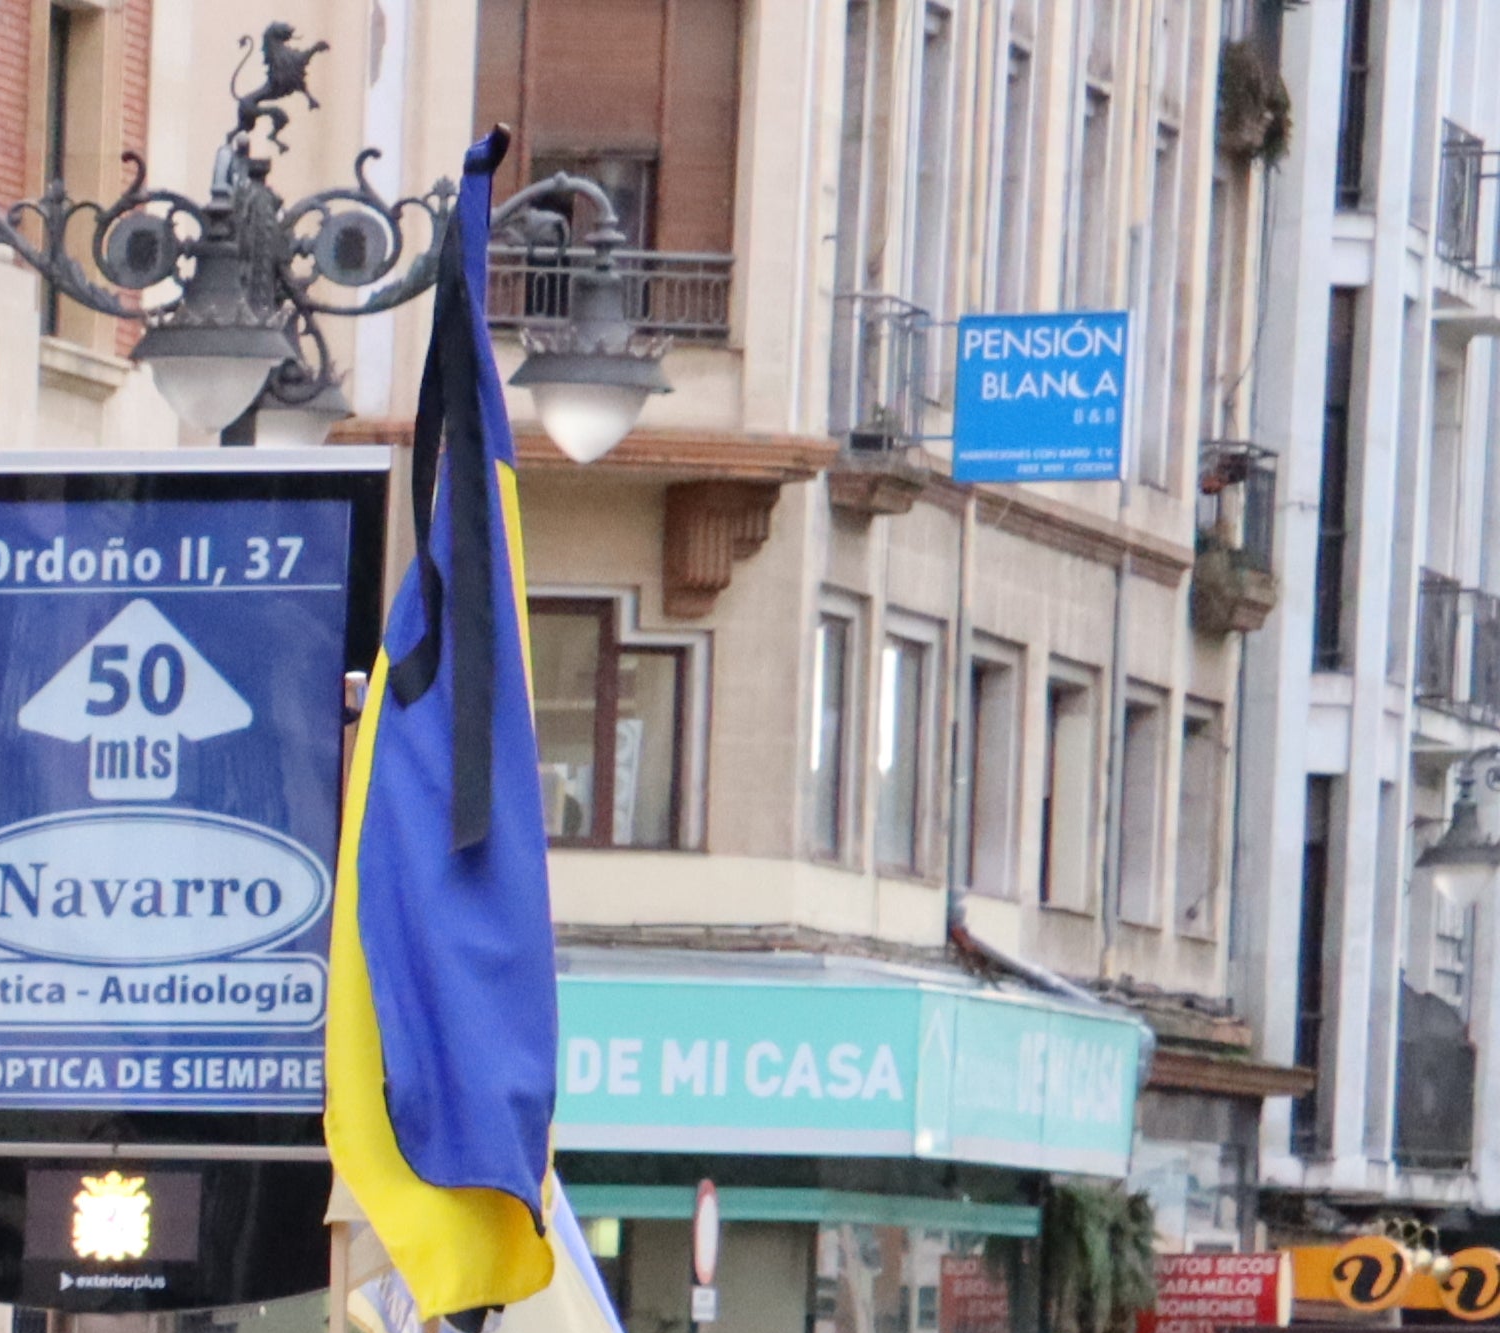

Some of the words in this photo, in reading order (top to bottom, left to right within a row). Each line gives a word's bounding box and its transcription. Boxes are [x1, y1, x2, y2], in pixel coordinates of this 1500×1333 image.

[964, 318, 1123, 361] PENSIÓN
[981, 369, 1119, 400] BLANCA
[245, 538, 303, 581] 37
[85, 643, 186, 717] 50
[94, 735, 172, 782] mts
[99, 973, 314, 1012] Audiología
[117, 1058, 162, 1089] DE
[172, 1058, 324, 1090] SIEMPRE
[565, 1038, 643, 1096] DE
[660, 1040, 729, 1096] MI
[744, 1041, 904, 1100] CASA
